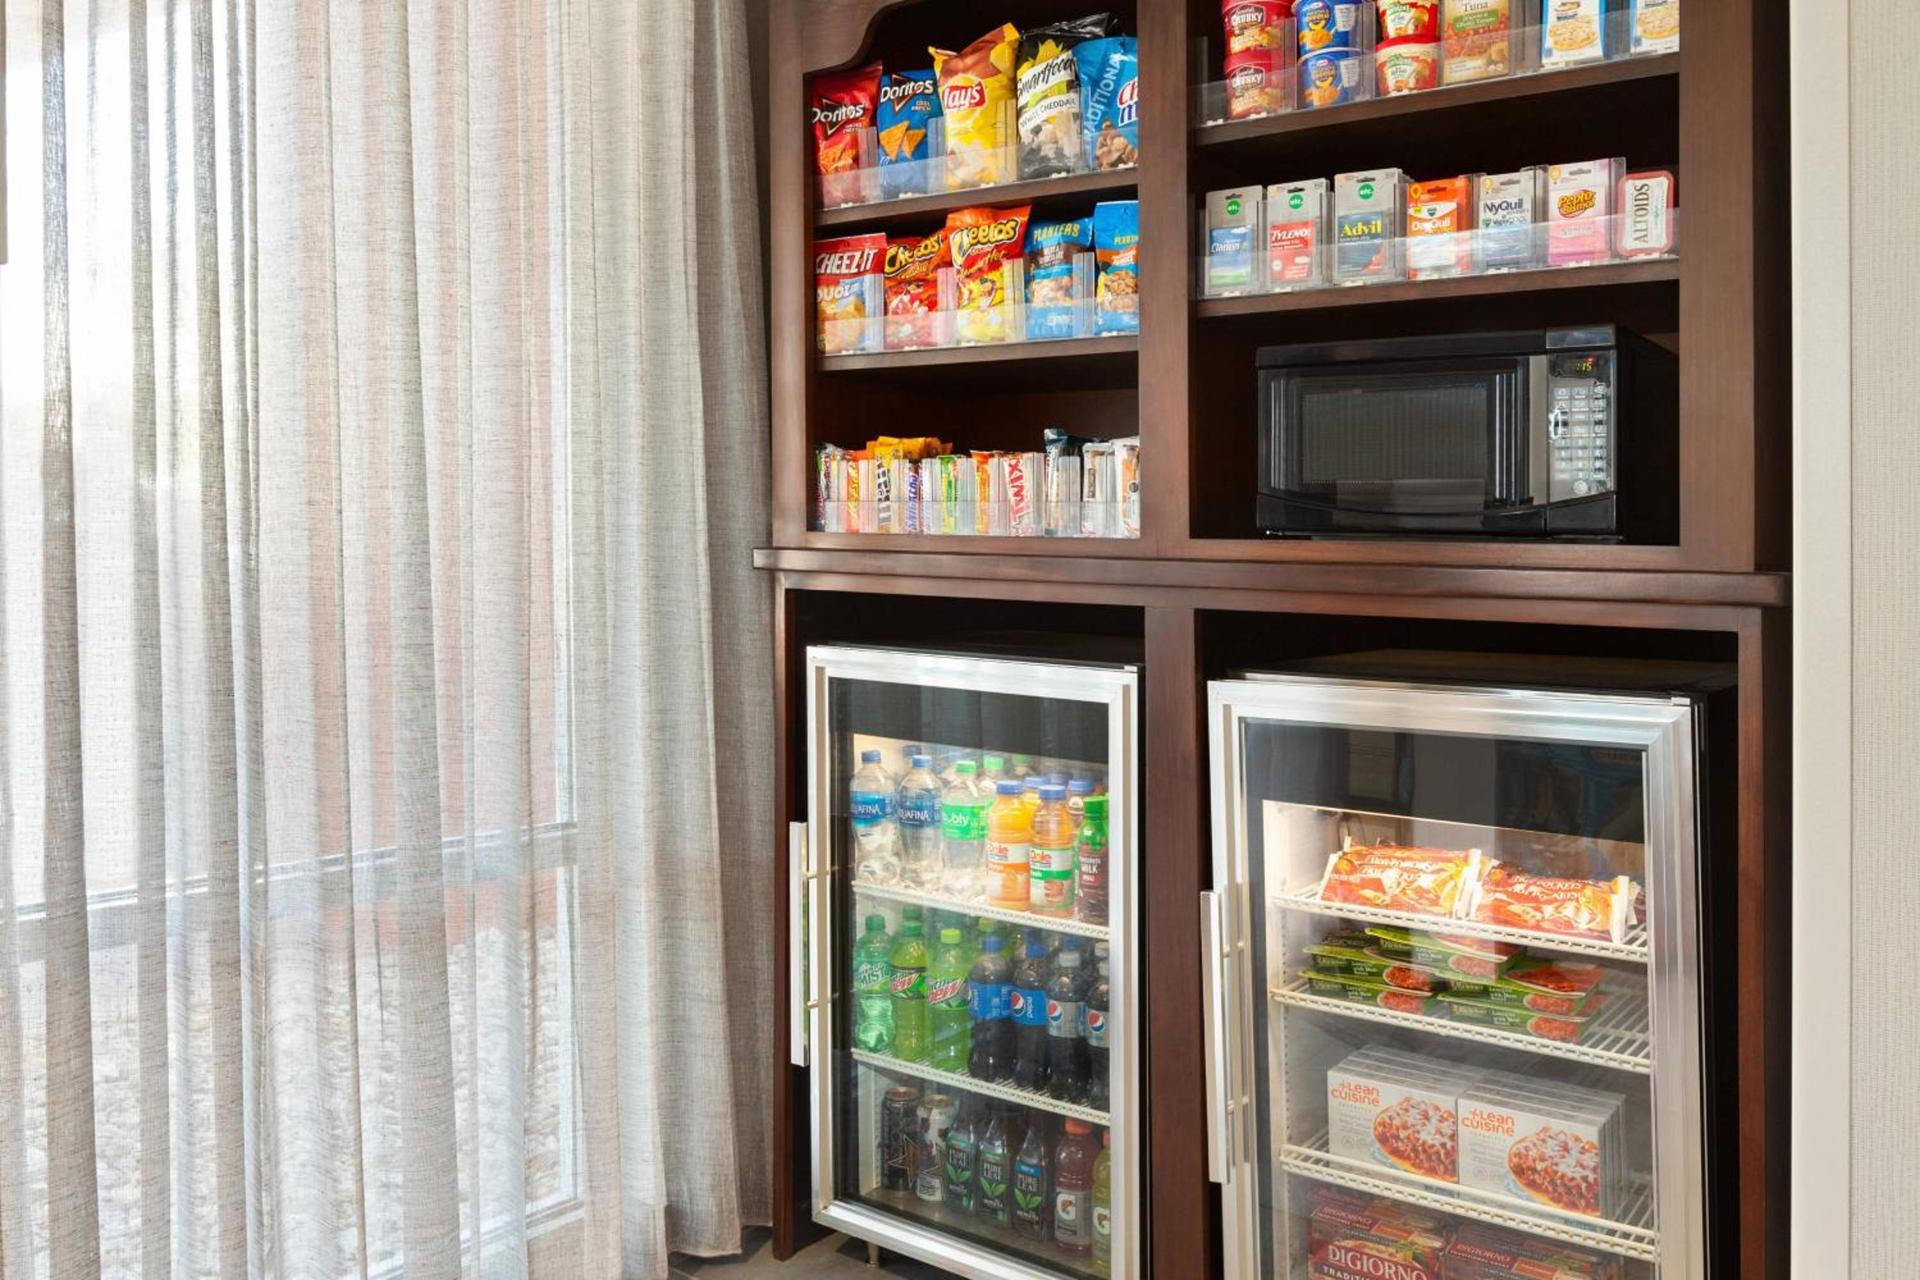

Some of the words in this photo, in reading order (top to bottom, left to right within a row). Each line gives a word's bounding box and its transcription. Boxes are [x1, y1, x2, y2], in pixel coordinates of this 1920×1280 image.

[881, 80, 935, 103] Doritos
[1483, 198, 1524, 215] NyQuil
[1632, 183, 1650, 244] ALTOIDS
[1341, 219, 1382, 238] Advil
[1480, 1110, 1515, 1127] Lean
[1328, 1245, 1429, 1280] DIGIORNO
